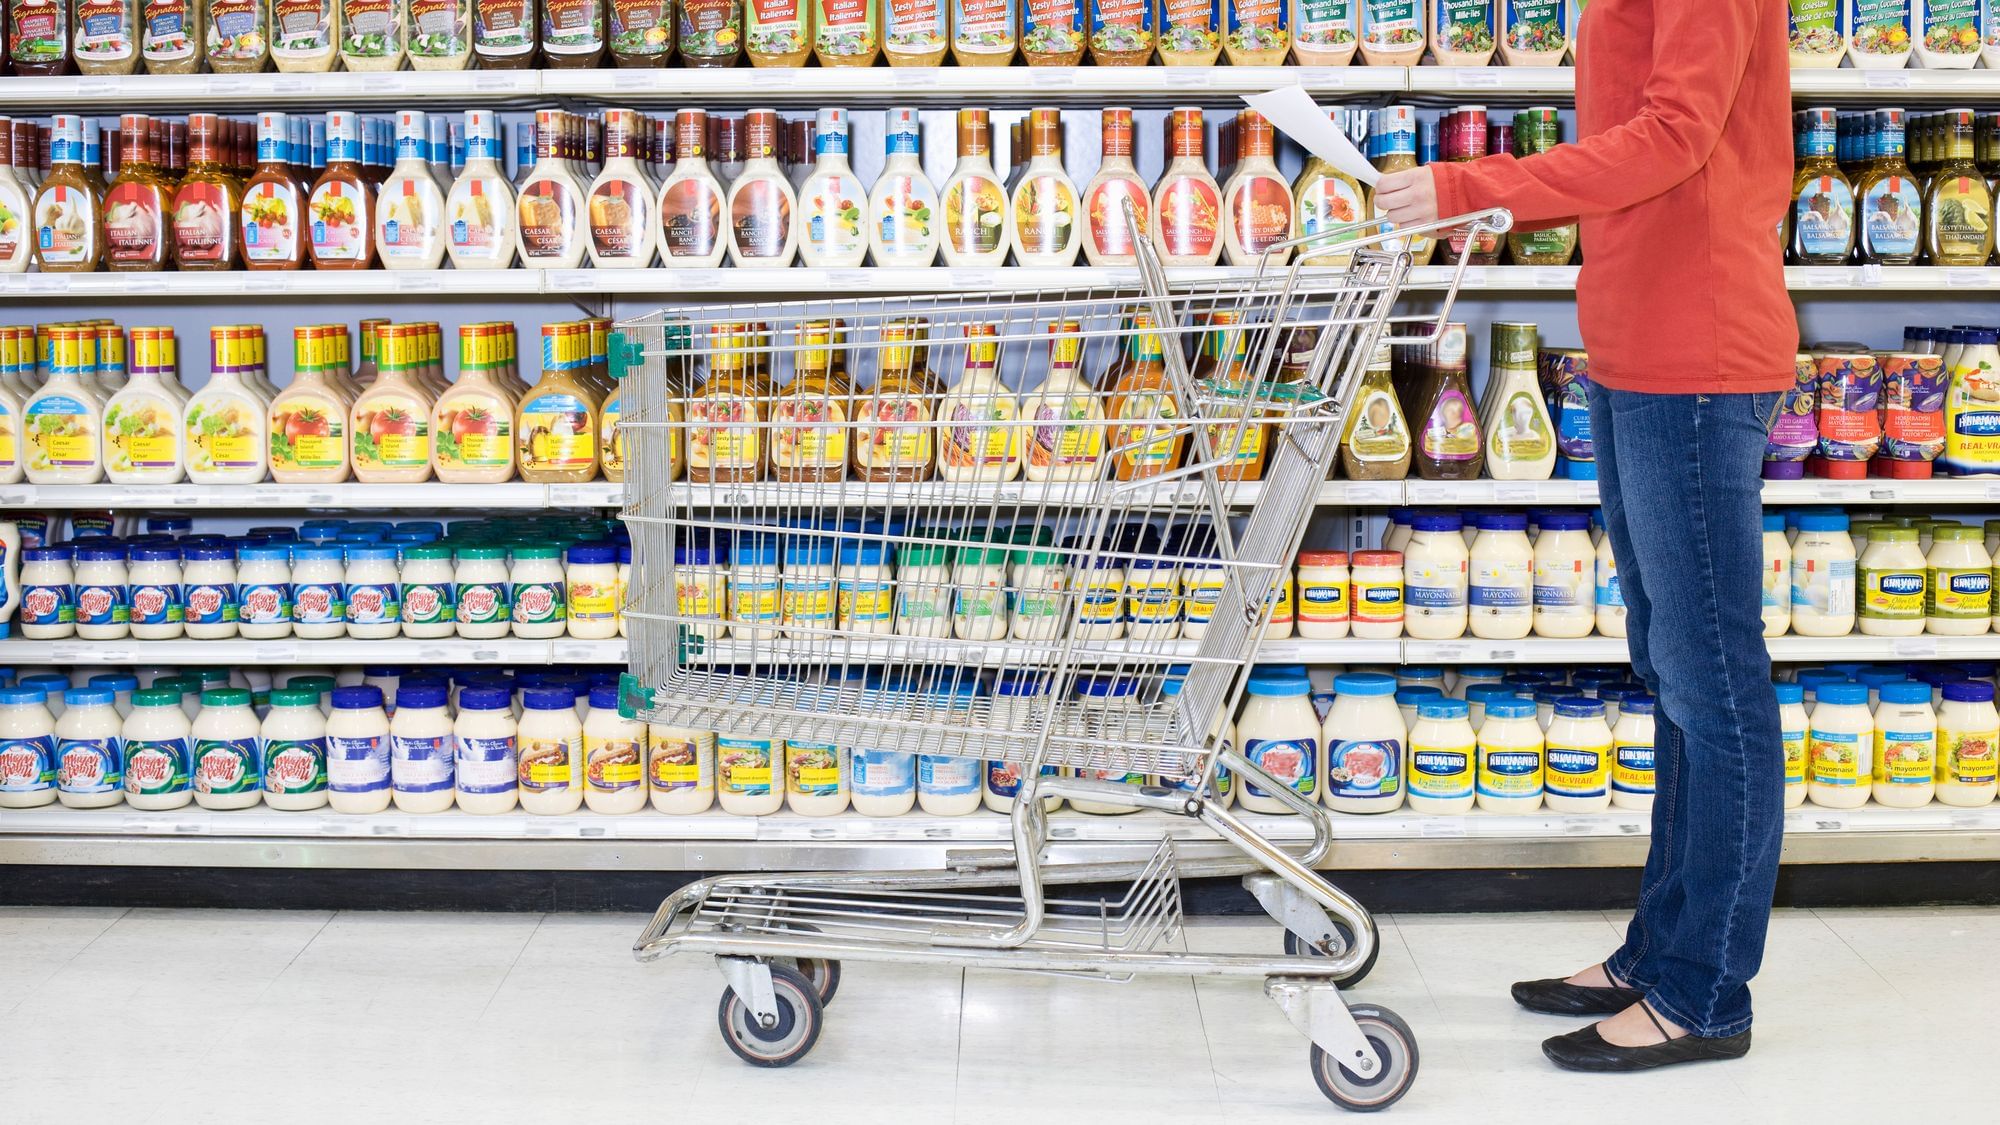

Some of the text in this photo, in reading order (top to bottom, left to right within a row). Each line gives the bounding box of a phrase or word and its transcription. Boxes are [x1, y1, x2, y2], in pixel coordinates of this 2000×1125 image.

[763, 0, 789, 9] Italian
[833, 0, 858, 10] Italian
[894, 1, 914, 13] Zesty
[964, 1, 984, 13] Zesty
[1032, 0, 1051, 11] Zesty
[1101, 0, 1120, 10] Zesty
[1169, 0, 1188, 10] Golden
[1302, 0, 1325, 11] Thousand
[1366, 0, 1391, 12] Thousand
[1800, 0, 1829, 12] Coleslaw
[1858, 2, 1880, 14] Creamy
[1929, 2, 1951, 14] Creamy
[12, 7, 61, 20] Signature
[760, 8, 795, 20] Italienne
[829, 9, 864, 21] Italienne
[914, 9, 942, 22] piquante
[1051, 8, 1081, 20] piquante
[1121, 6, 1149, 19] piquante
[1261, 6, 1283, 17] Golden
[1791, 8, 1838, 24] Salade de chou
[1886, 7, 1909, 19] concombre
[1957, 7, 1980, 19] concombre
[536, 236, 558, 244] CÉSAR
[1828, 415, 1865, 423] HORSERADISH
[1894, 415, 1932, 423] HORSERADISH
[133, 451, 148, 459] César
[1415, 590, 1463, 599] MAYONNAISE
[1891, 596, 1907, 604] Olive
[1817, 764, 1854, 773] mayonnaise
[1894, 765, 1930, 773] mayonnaise
[1961, 765, 1995, 773] mayonnaise
